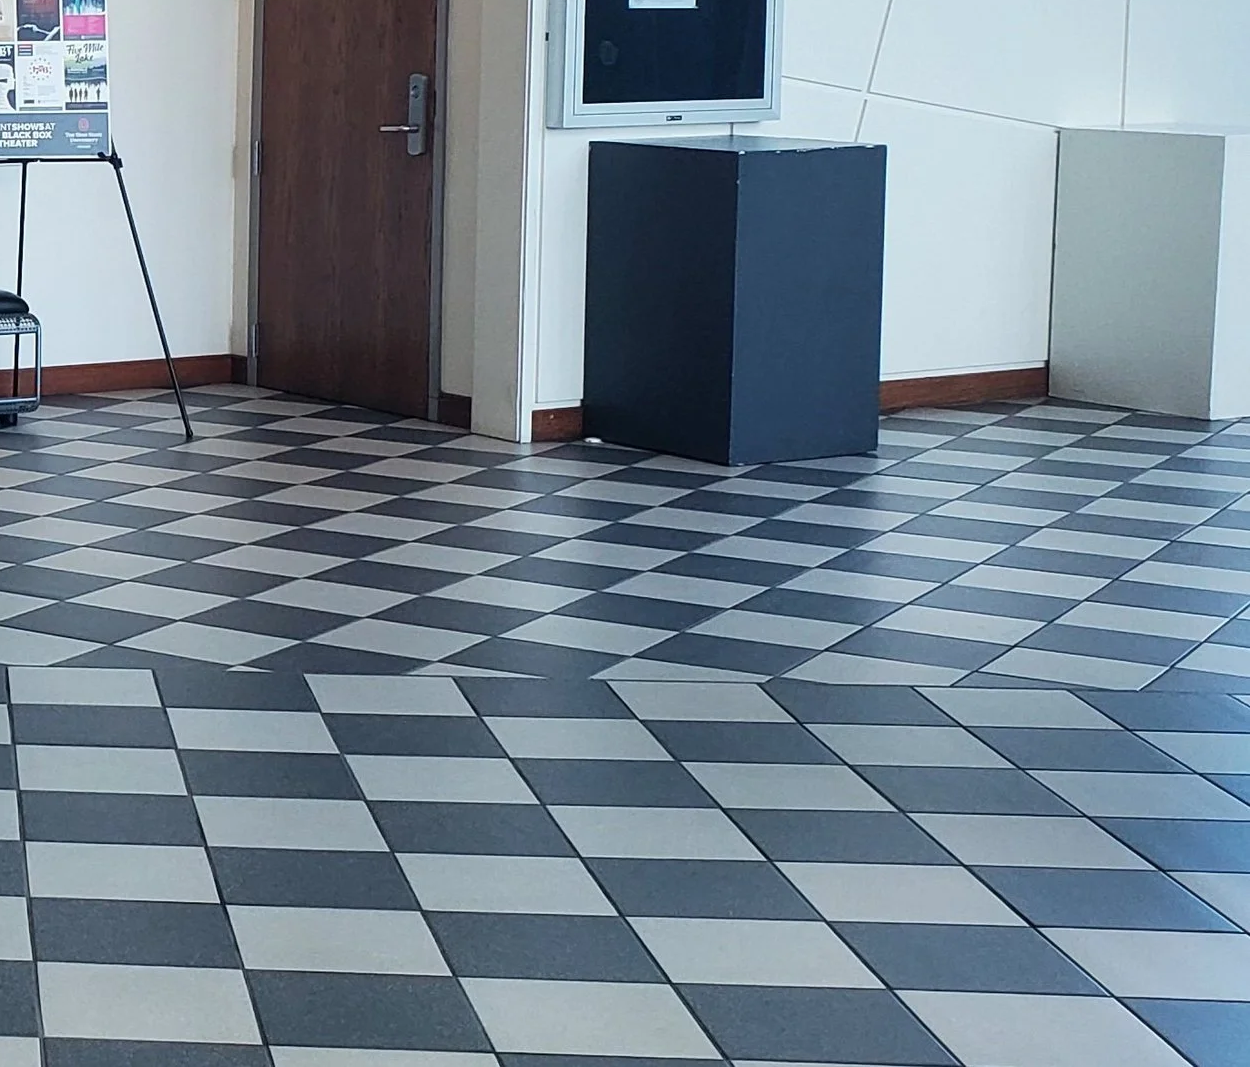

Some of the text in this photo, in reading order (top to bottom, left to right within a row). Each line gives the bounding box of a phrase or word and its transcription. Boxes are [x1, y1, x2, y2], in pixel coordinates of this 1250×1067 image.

[83, 43, 104, 53] Mile
[12, 123, 45, 131] SHOWS
[45, 122, 56, 131] AT
[1, 131, 31, 139] BLACK
[32, 131, 53, 139] BOX
